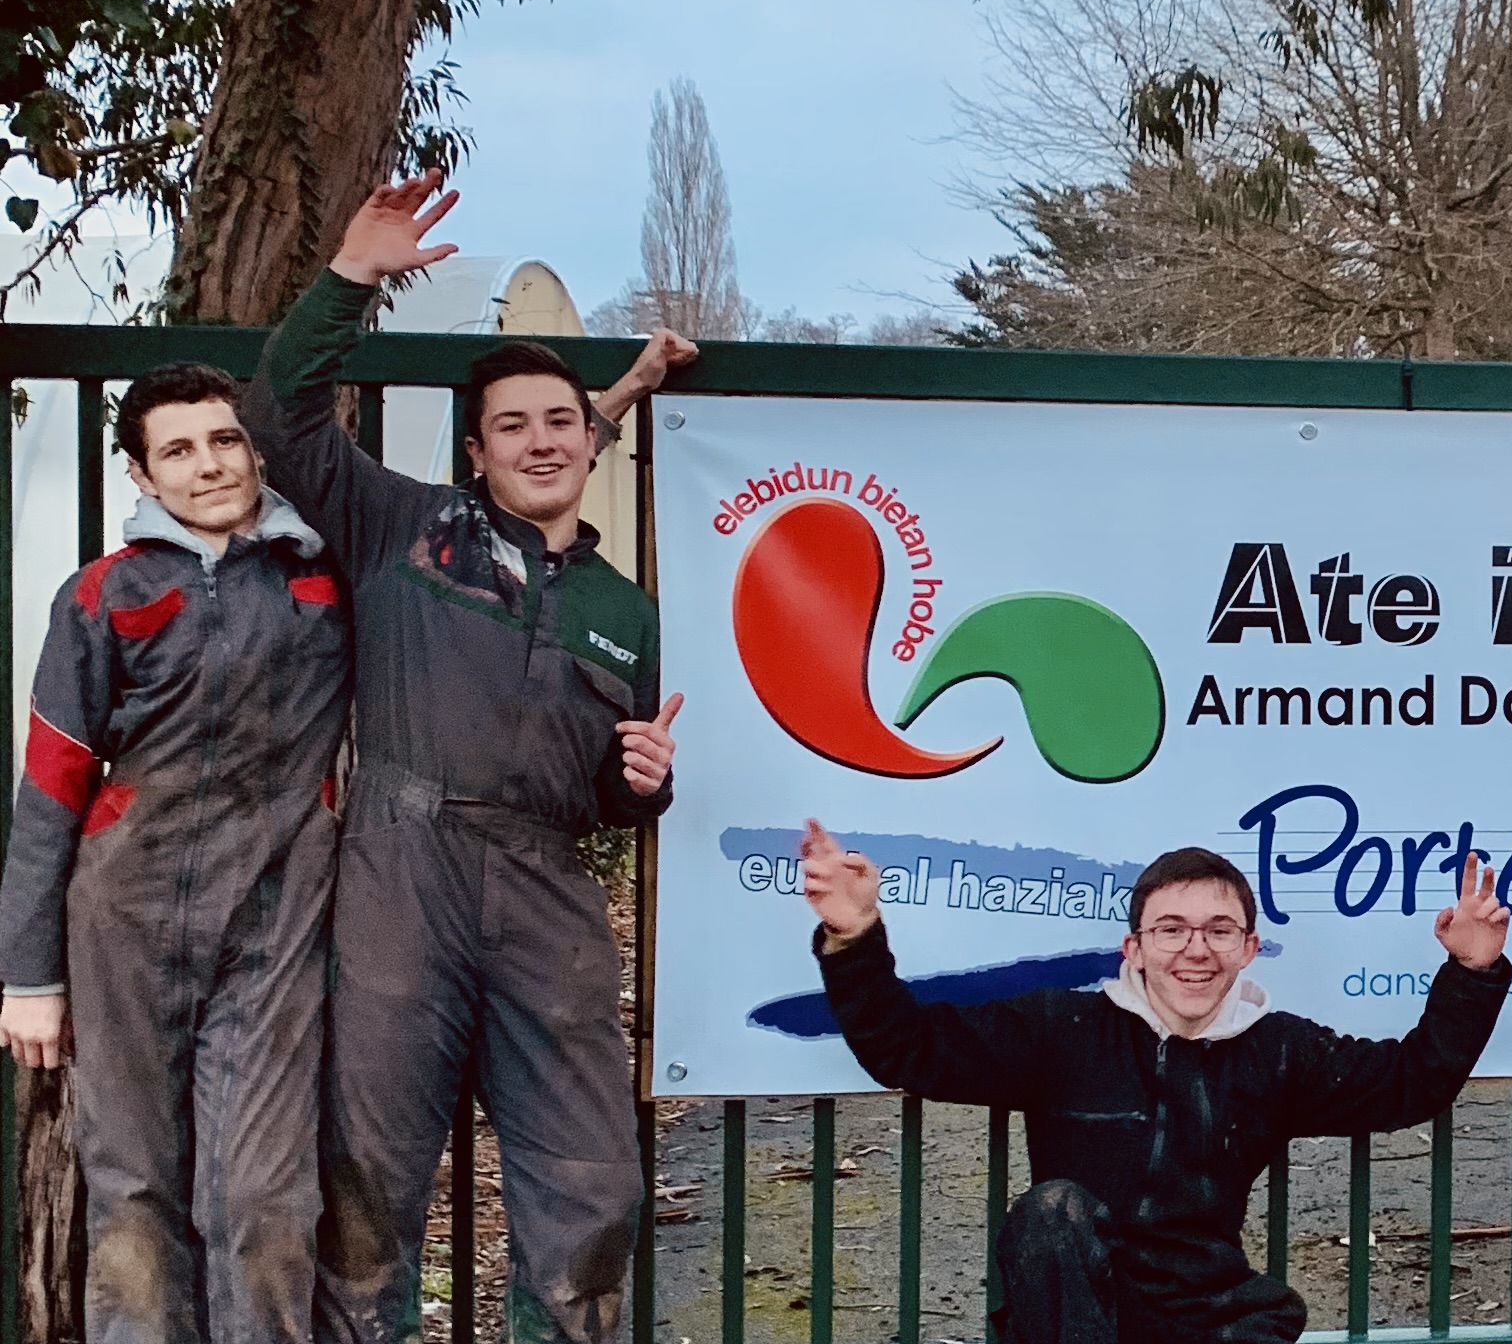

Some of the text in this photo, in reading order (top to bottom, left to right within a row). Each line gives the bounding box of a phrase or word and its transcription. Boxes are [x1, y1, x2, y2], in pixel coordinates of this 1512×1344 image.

[713, 461, 943, 663] elebidun bietan hobe
[1207, 542, 1441, 646] Ate
[588, 630, 639, 665] FENDT
[1186, 674, 1435, 726] Armand
[739, 852, 1132, 921] eual haziak
[1342, 966, 1431, 997] dans
